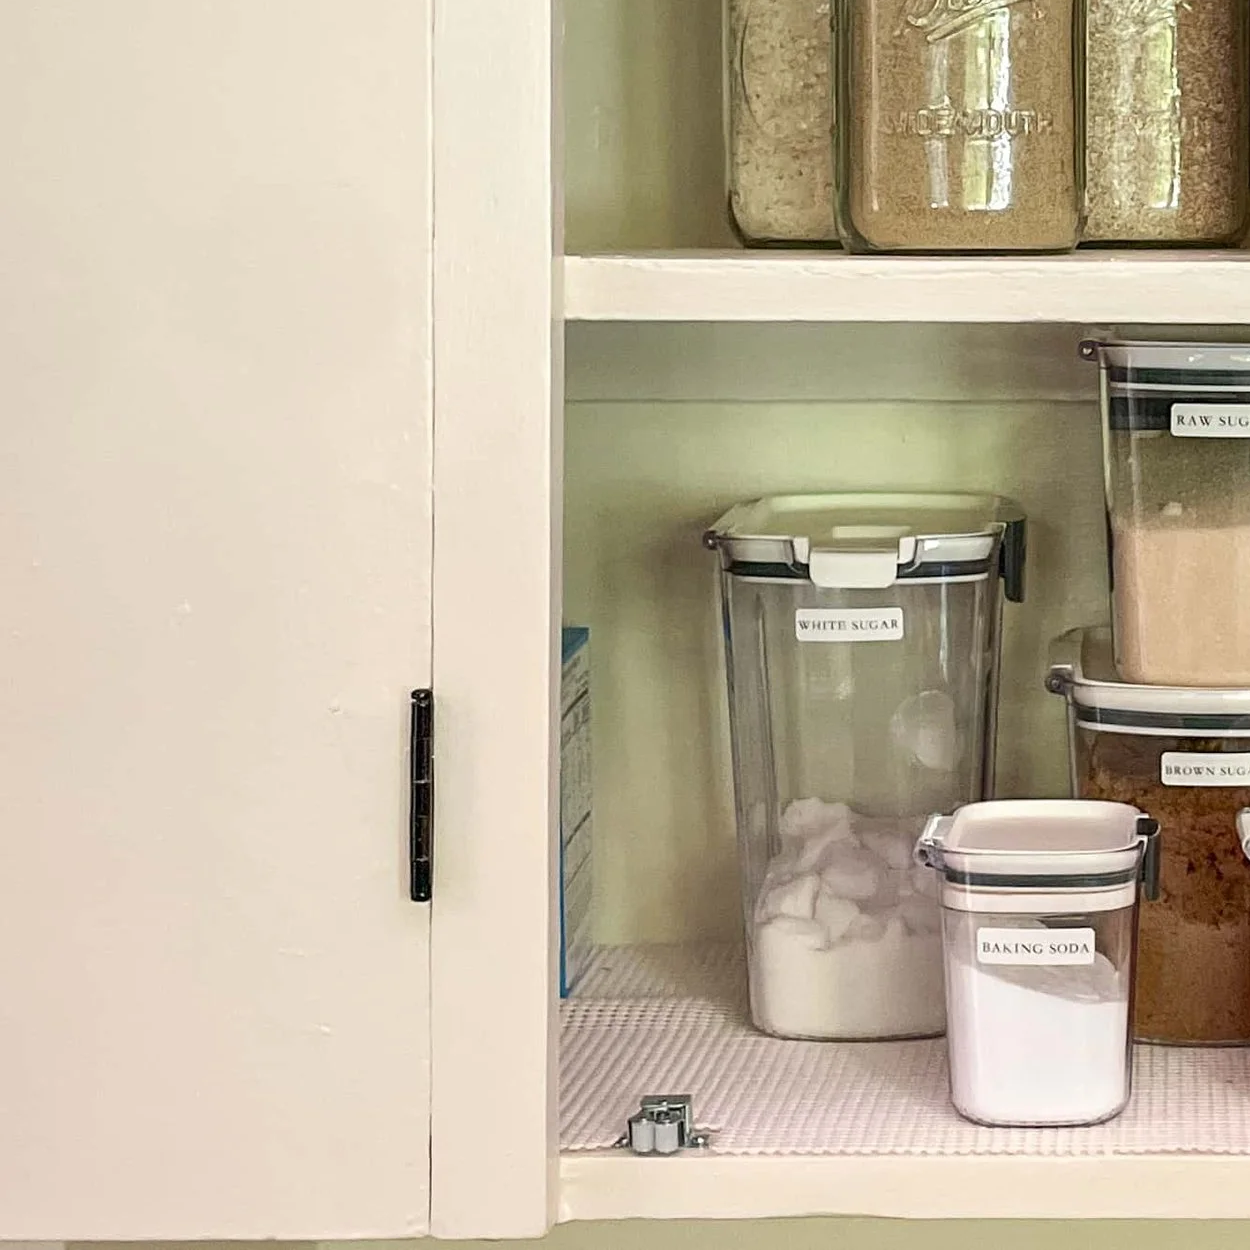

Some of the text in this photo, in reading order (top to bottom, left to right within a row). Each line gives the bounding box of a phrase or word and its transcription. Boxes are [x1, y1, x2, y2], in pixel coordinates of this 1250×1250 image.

[1176, 414, 1213, 427] RAW
[798, 618, 899, 632] WHITE SUGAR
[1165, 764, 1216, 776] BROWN
[982, 941, 1090, 955] BAKING SODA
